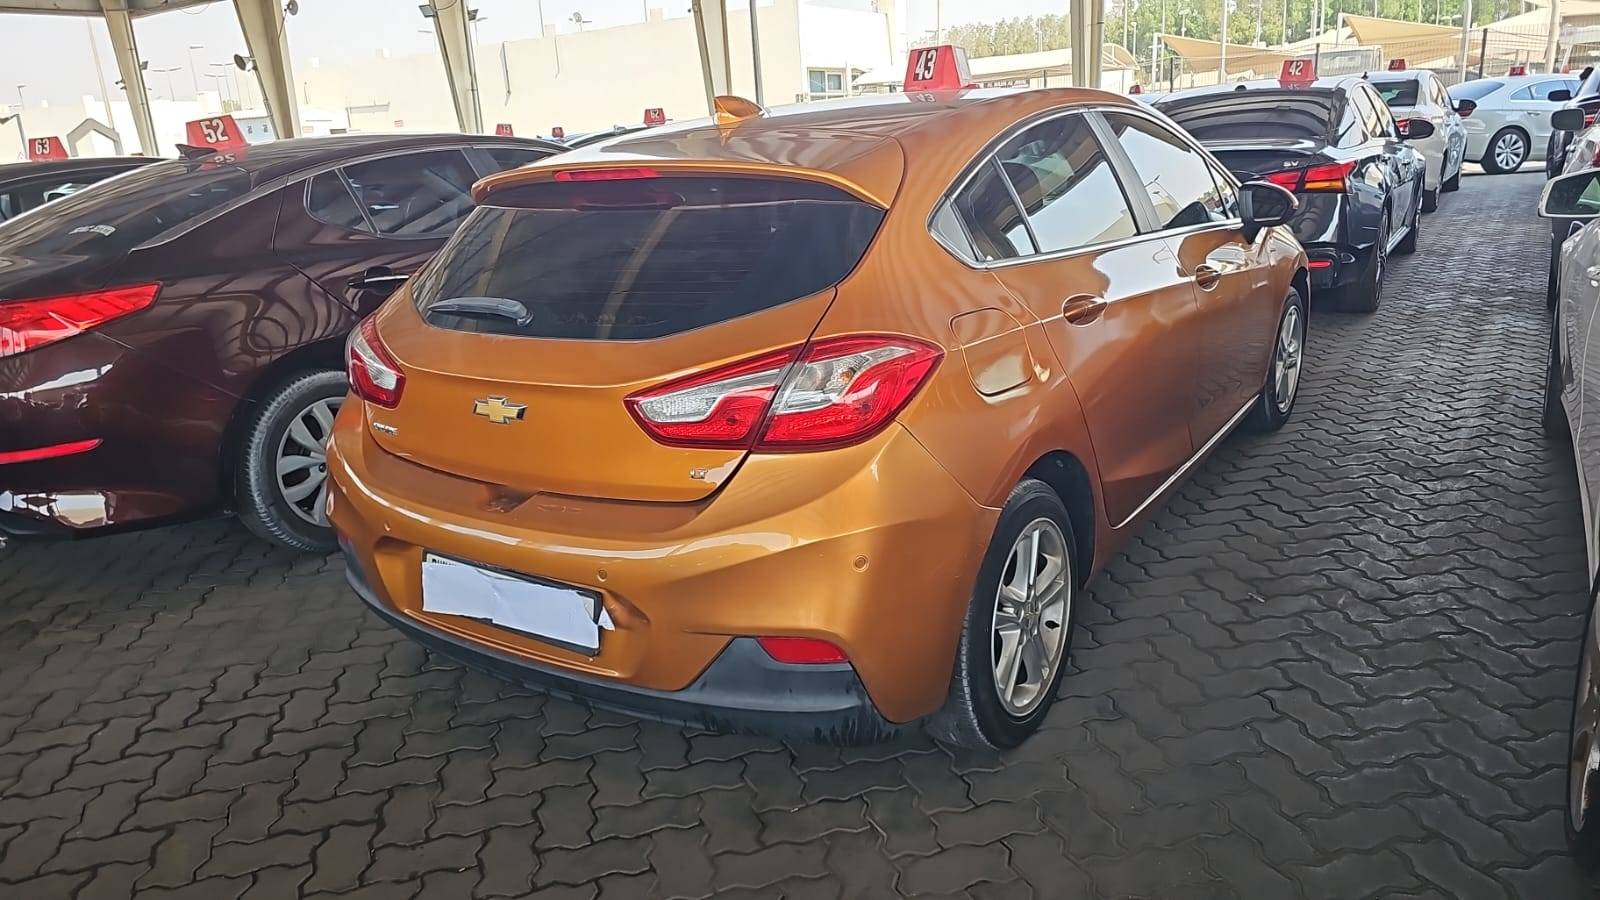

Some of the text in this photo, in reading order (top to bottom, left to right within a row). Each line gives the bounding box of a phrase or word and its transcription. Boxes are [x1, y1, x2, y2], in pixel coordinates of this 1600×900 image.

[914, 49, 937, 80] 43
[1288, 61, 1303, 76] 42
[200, 118, 230, 144] 52
[35, 138, 50, 155] 63
